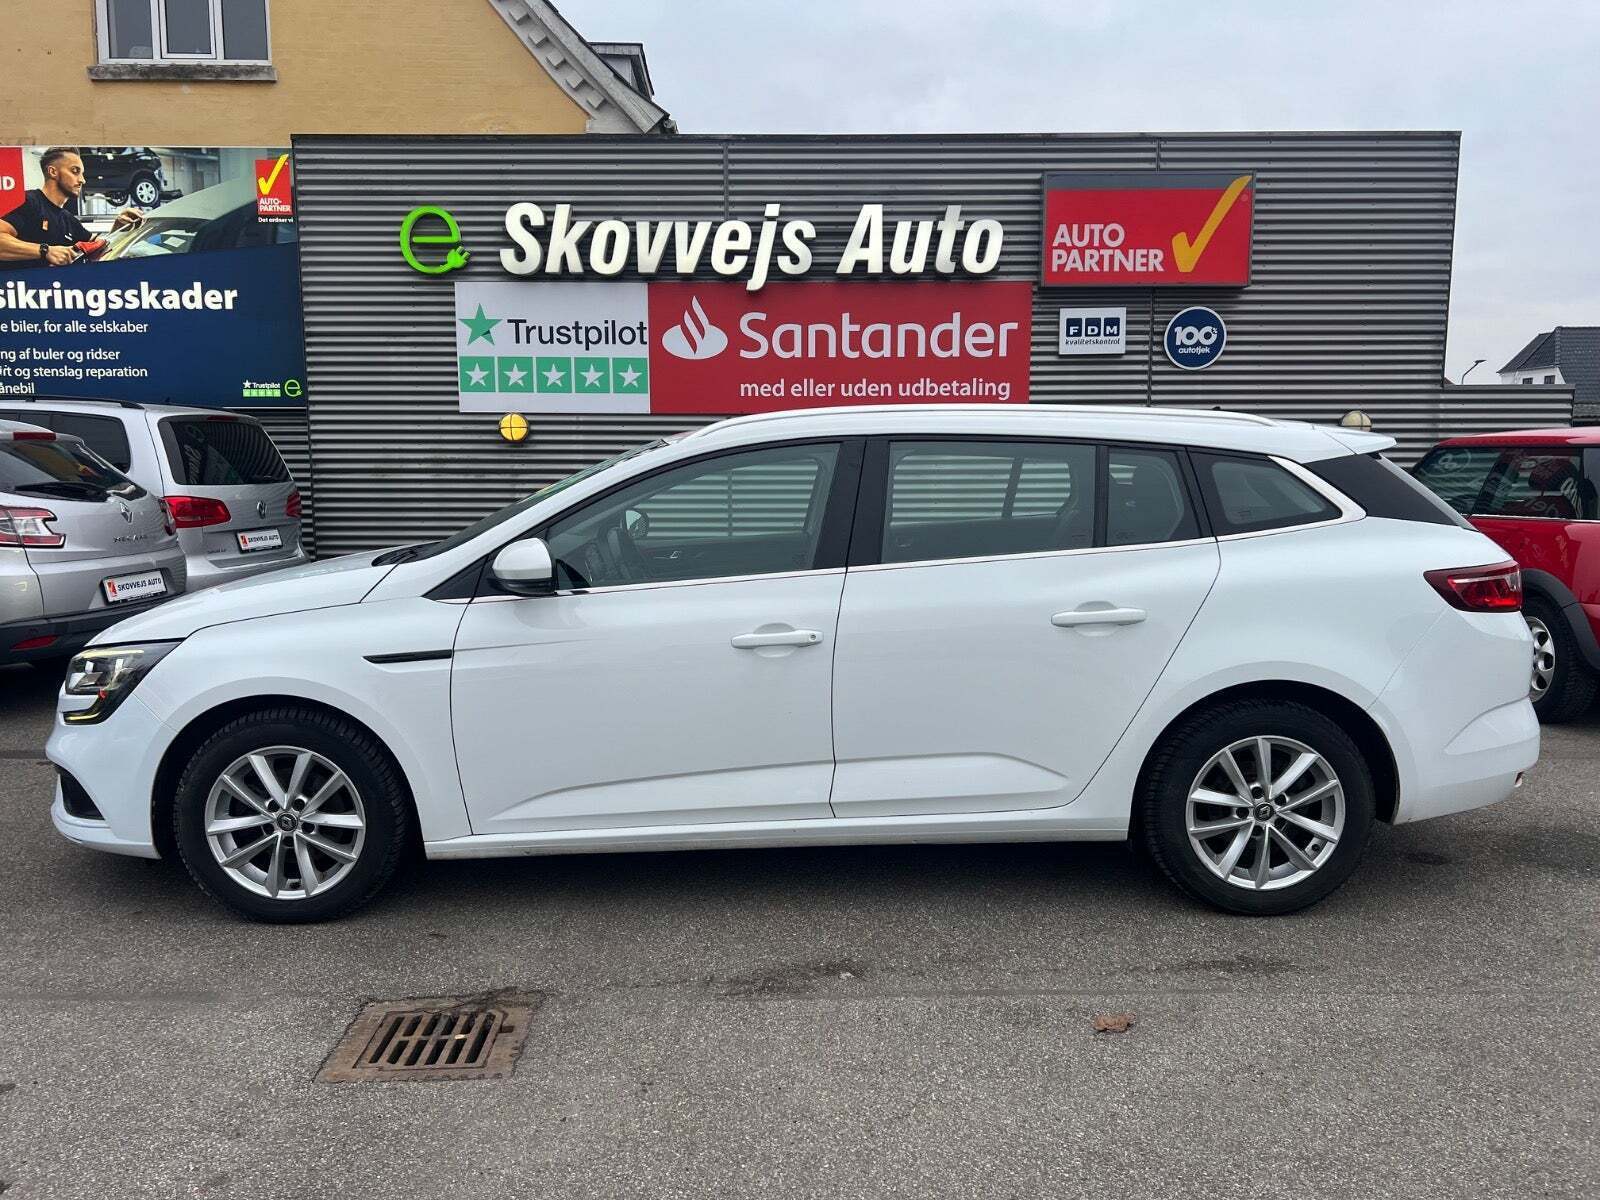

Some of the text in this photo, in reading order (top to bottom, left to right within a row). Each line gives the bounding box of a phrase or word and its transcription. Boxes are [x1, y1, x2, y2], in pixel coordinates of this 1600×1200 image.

[1052, 223, 1125, 247] AUTO
[500, 202, 1004, 292] Skovvejs Auto
[1051, 249, 1164, 272] PARTNER
[11, 320, 41, 334] biler,
[44, 320, 62, 333] for
[64, 320, 87, 333] alle
[89, 320, 148, 333] selskaber
[1069, 325, 1118, 336] FDM
[507, 319, 648, 351] Trustpilot
[739, 312, 1018, 359] Santander
[19, 348, 31, 360] af
[33, 348, 65, 360] buler
[67, 350, 84, 362] og
[86, 348, 120, 361] ridser
[1178, 346, 1211, 355] autotjek
[14, 367, 31, 379] og
[33, 365, 83, 379] stenslag
[86, 366, 148, 379] reparation
[252, 382, 281, 390] Trustpilot
[740, 378, 1011, 400] med eller uden udbetaling
[117, 578, 162, 592] SKOVVEJS AUTO
